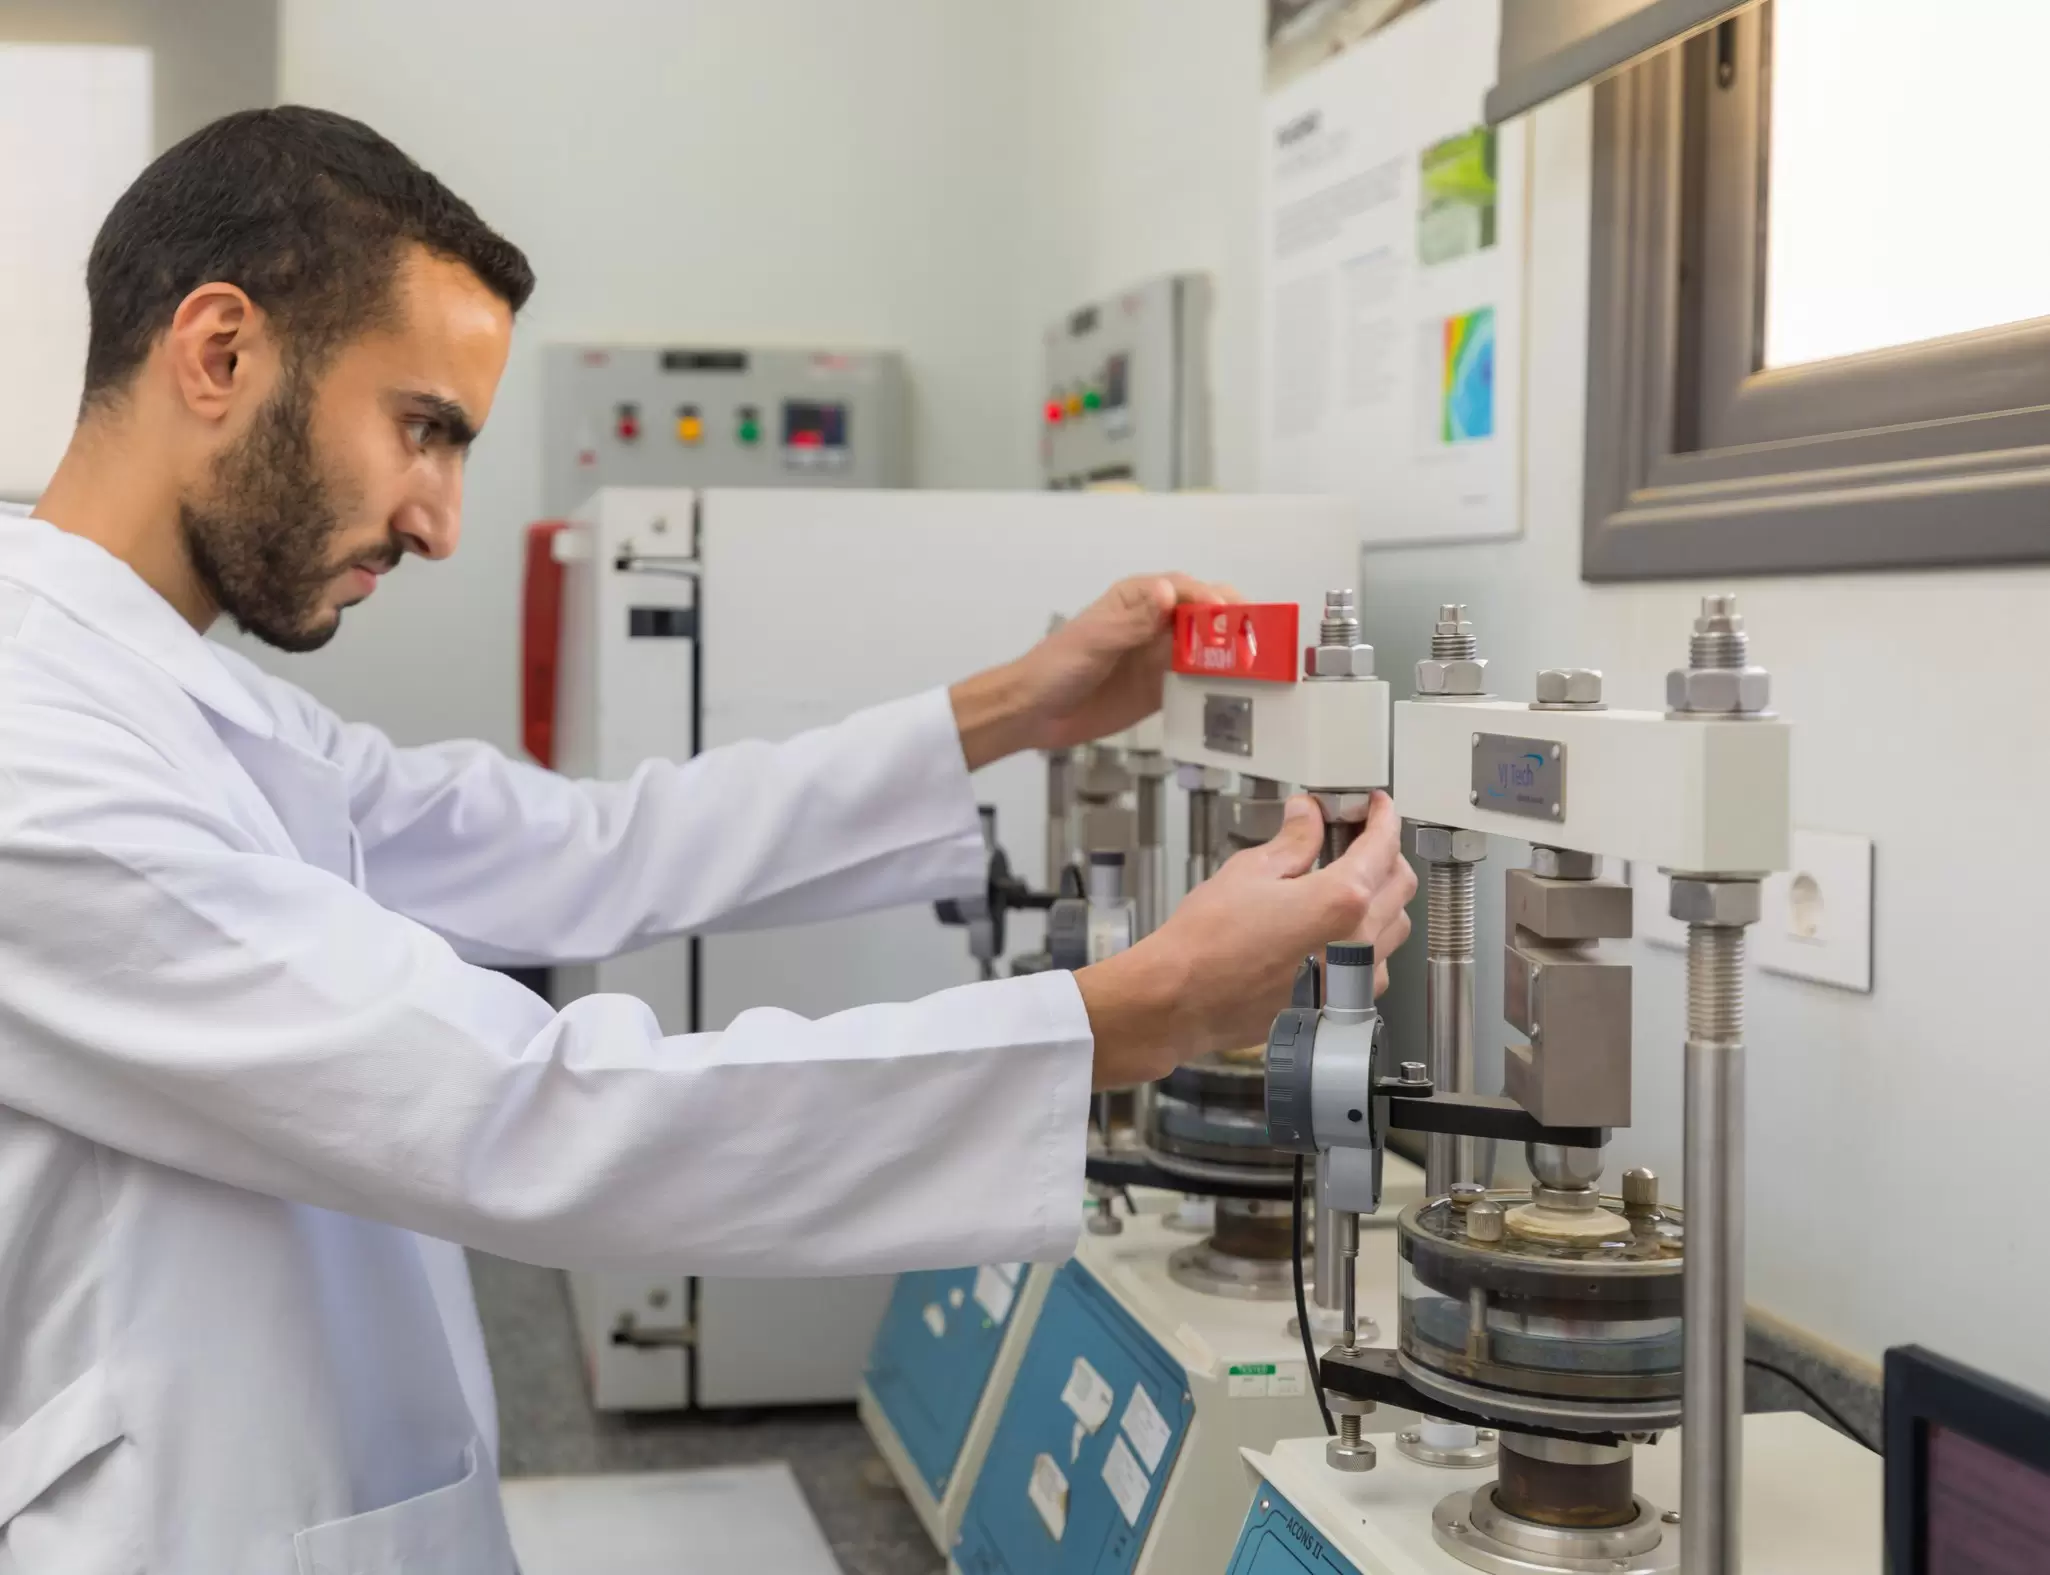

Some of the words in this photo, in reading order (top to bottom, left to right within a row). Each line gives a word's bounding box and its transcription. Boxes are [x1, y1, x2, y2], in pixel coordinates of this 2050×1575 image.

[1511, 763, 1533, 787] Tech
[1286, 1516, 1314, 1551] ACONS
[1312, 1541, 1324, 1560] II
